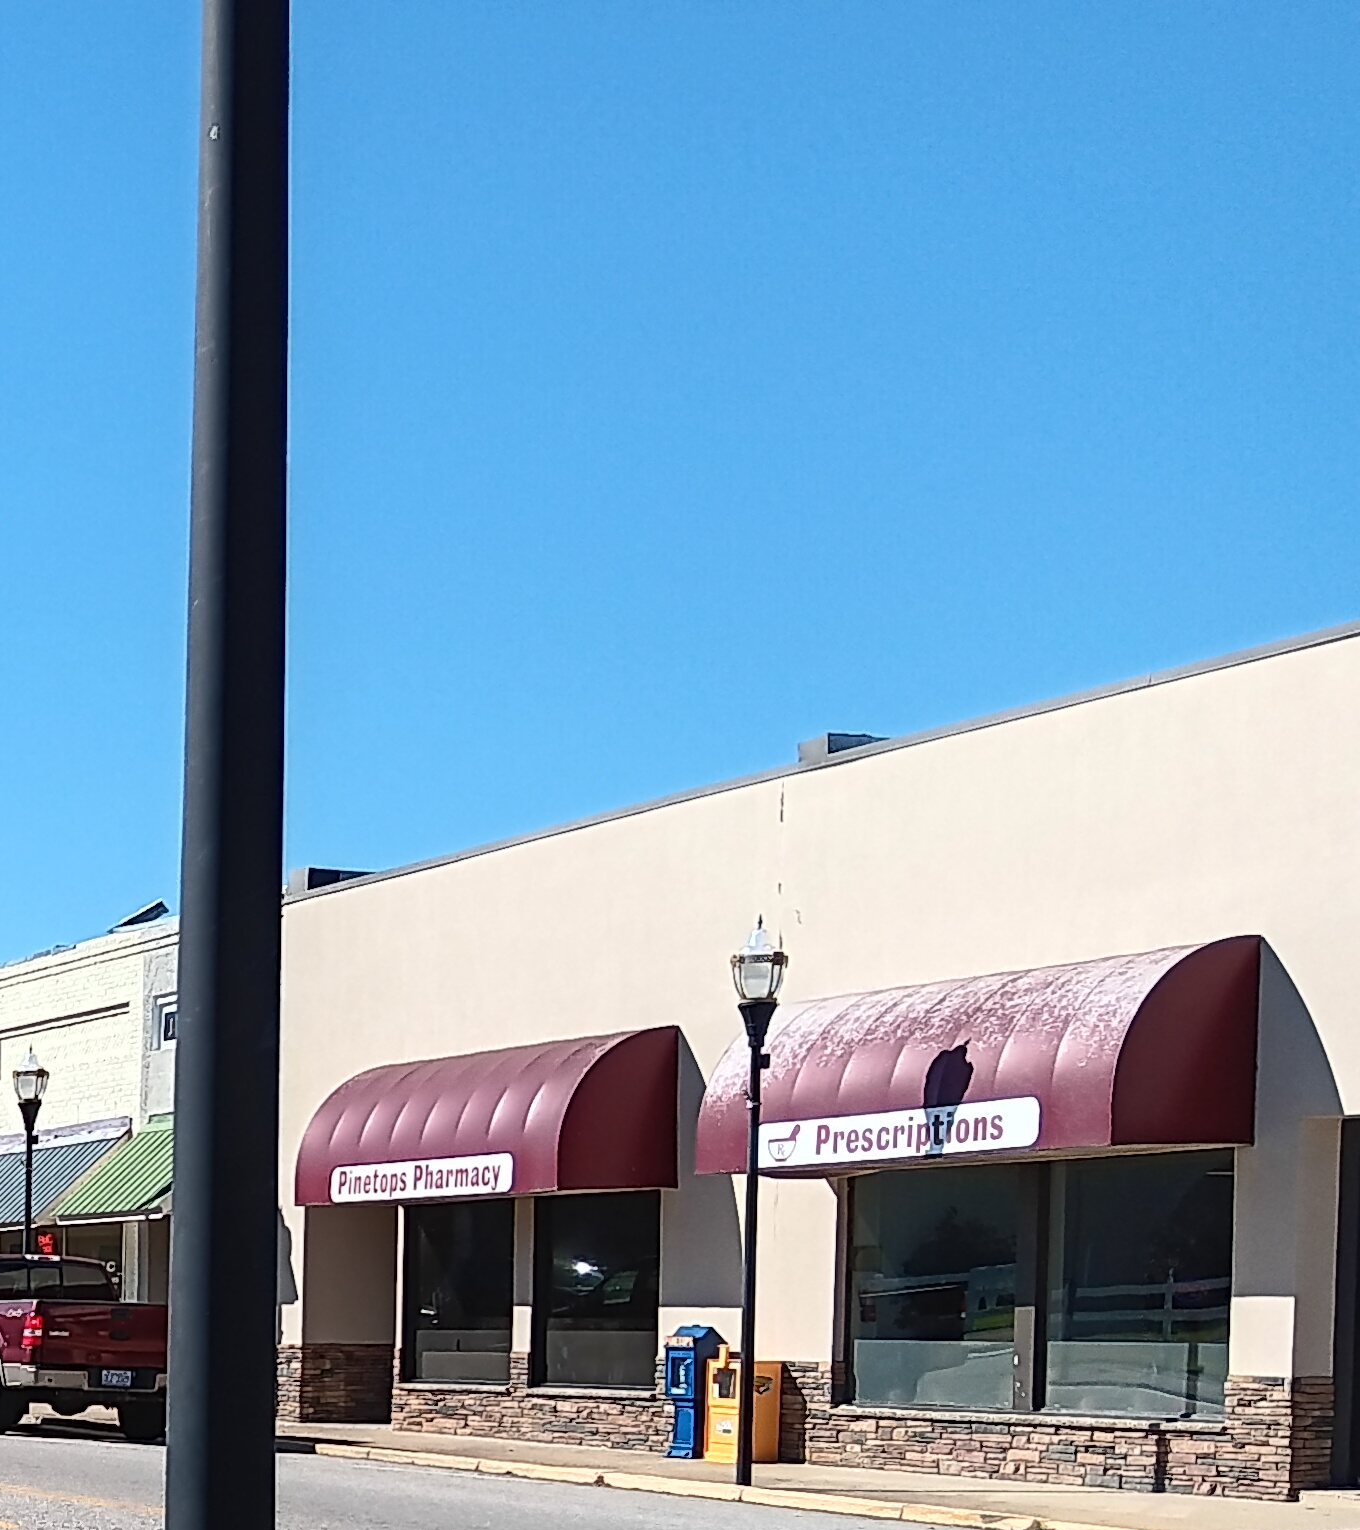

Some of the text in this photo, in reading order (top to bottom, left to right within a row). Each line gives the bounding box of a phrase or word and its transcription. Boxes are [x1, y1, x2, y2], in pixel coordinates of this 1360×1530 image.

[815, 1112, 1004, 1155] Prescriptions
[338, 1164, 501, 1197] Pinetops Pharmacy
